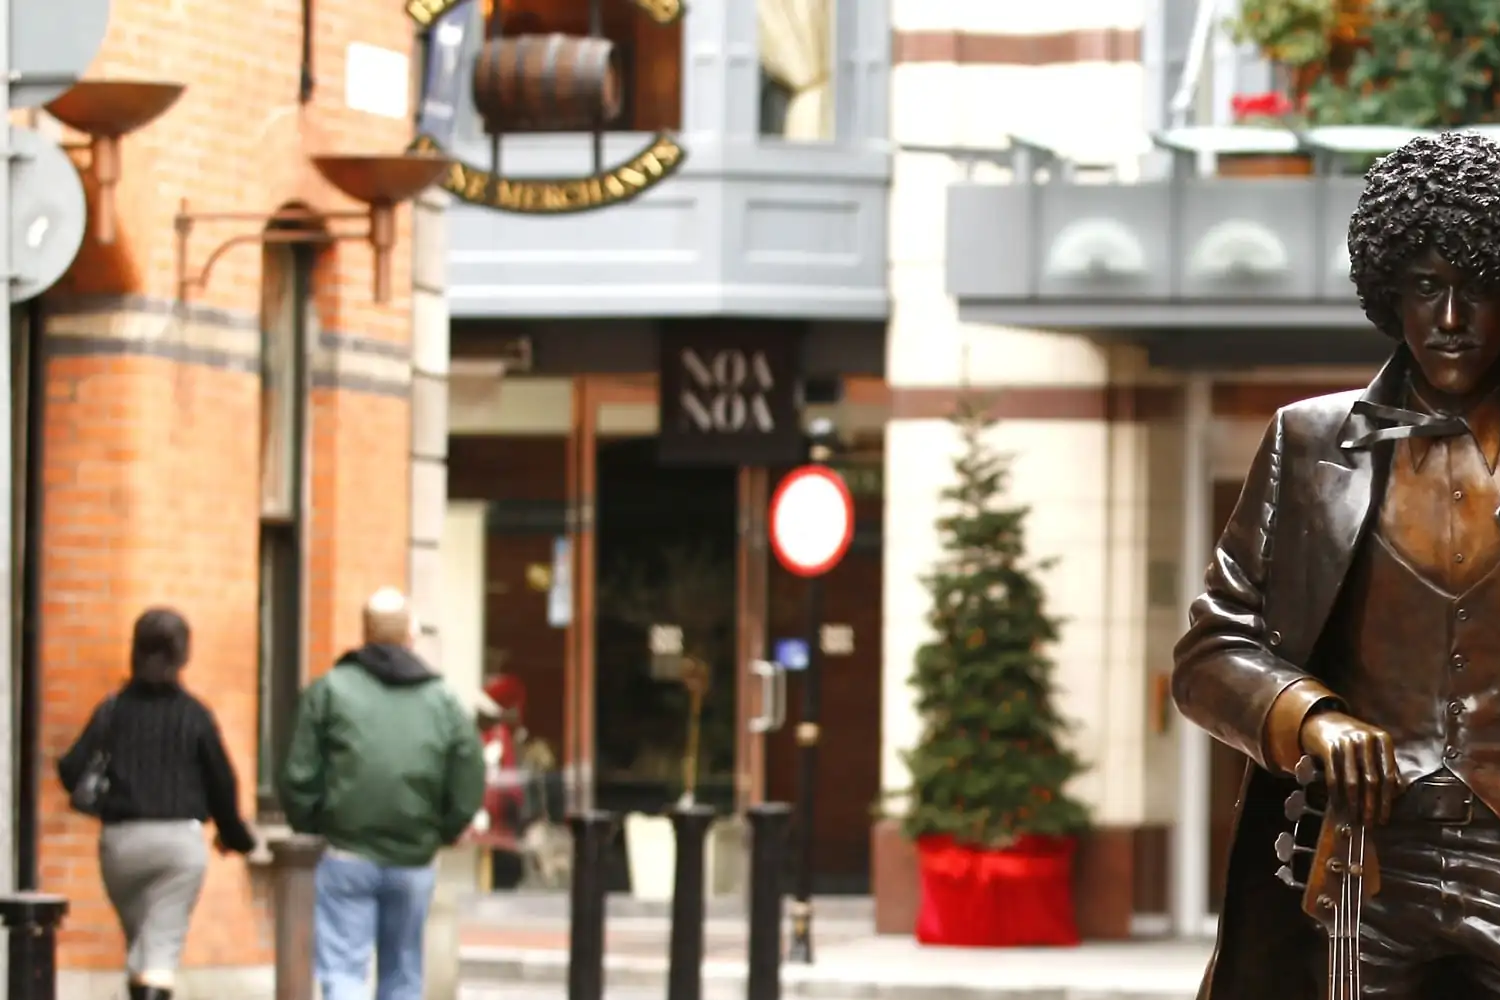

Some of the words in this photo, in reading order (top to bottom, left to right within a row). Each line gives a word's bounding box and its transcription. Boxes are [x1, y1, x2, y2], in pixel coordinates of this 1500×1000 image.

[498, 142, 681, 210] MERCHANTS
[681, 347, 775, 390] NOA
[680, 390, 775, 433] NOA
